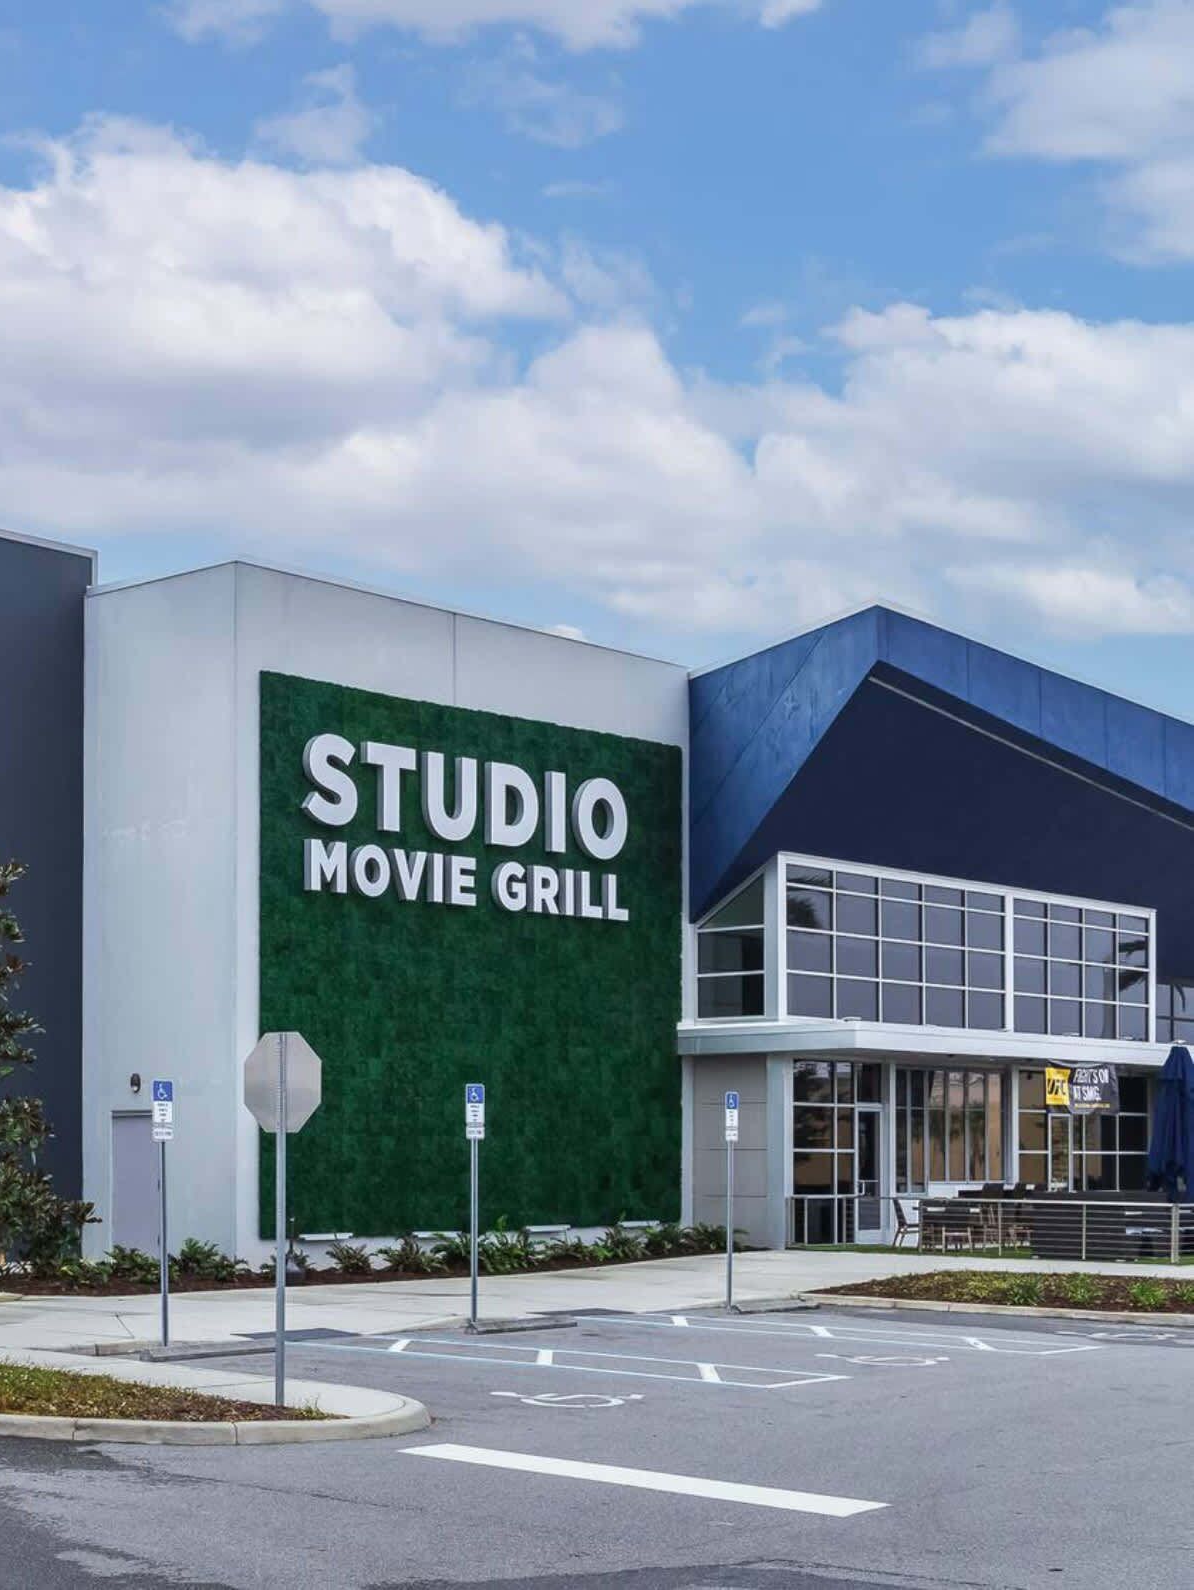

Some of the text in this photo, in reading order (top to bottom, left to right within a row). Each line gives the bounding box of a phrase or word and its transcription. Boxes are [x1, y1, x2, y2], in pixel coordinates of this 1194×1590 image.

[301, 733, 628, 860] STUDIO
[304, 838, 629, 921] MOVIE GRILL
[1047, 1078, 1067, 1096] UFC
